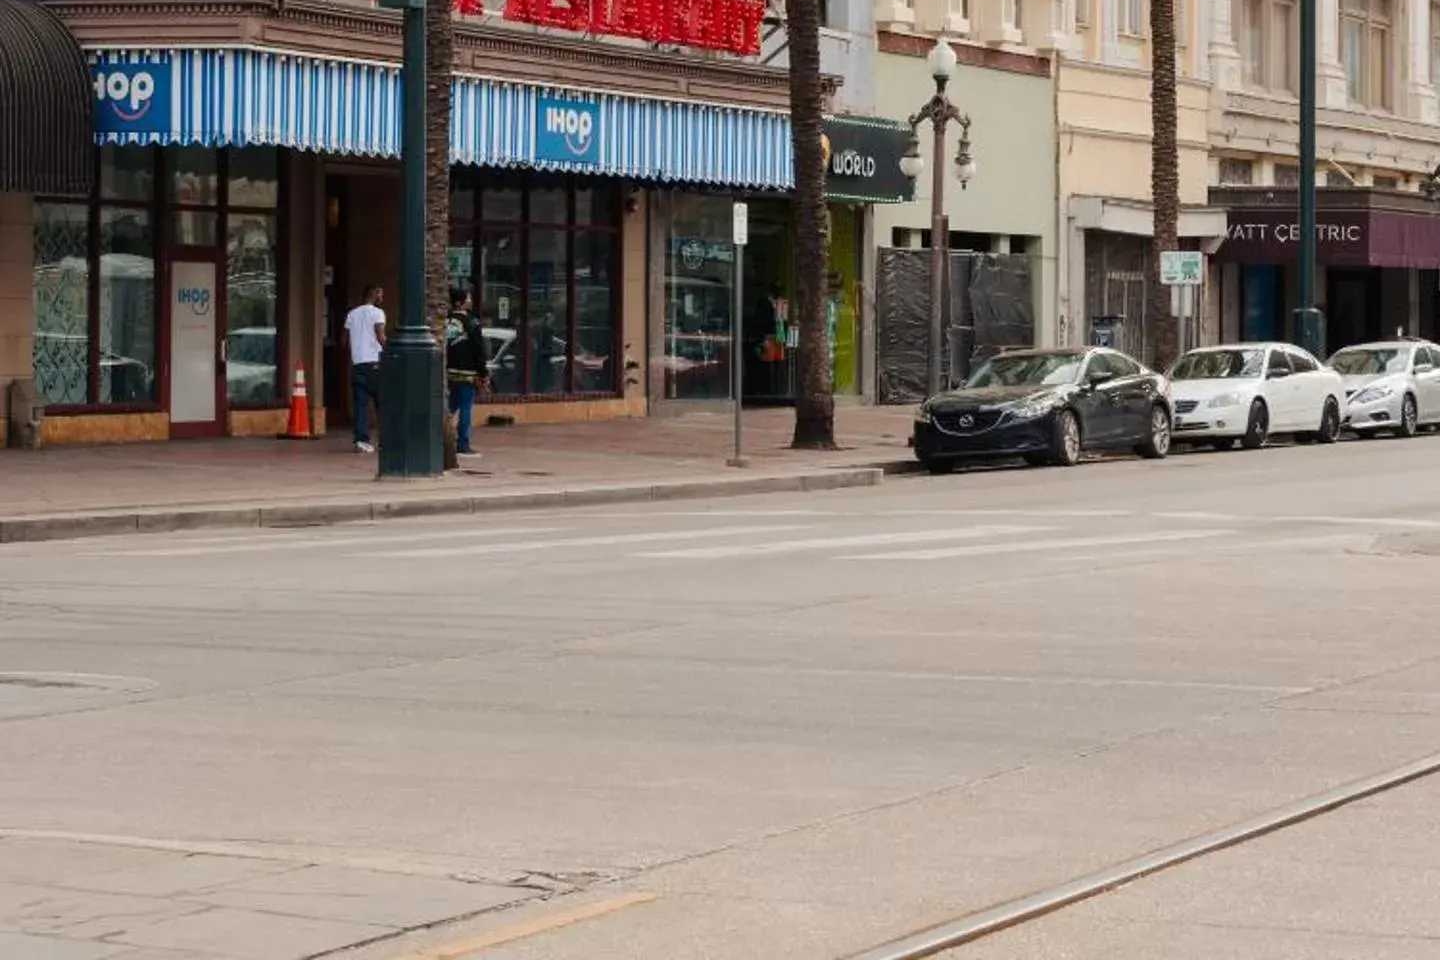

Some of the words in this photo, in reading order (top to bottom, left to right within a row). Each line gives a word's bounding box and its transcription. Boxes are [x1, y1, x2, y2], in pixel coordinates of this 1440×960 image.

[546, 107, 592, 144] IHOP
[832, 151, 876, 178] WORLD
[1274, 223, 1361, 243] CETRIC
[178, 288, 211, 308] IHOP
